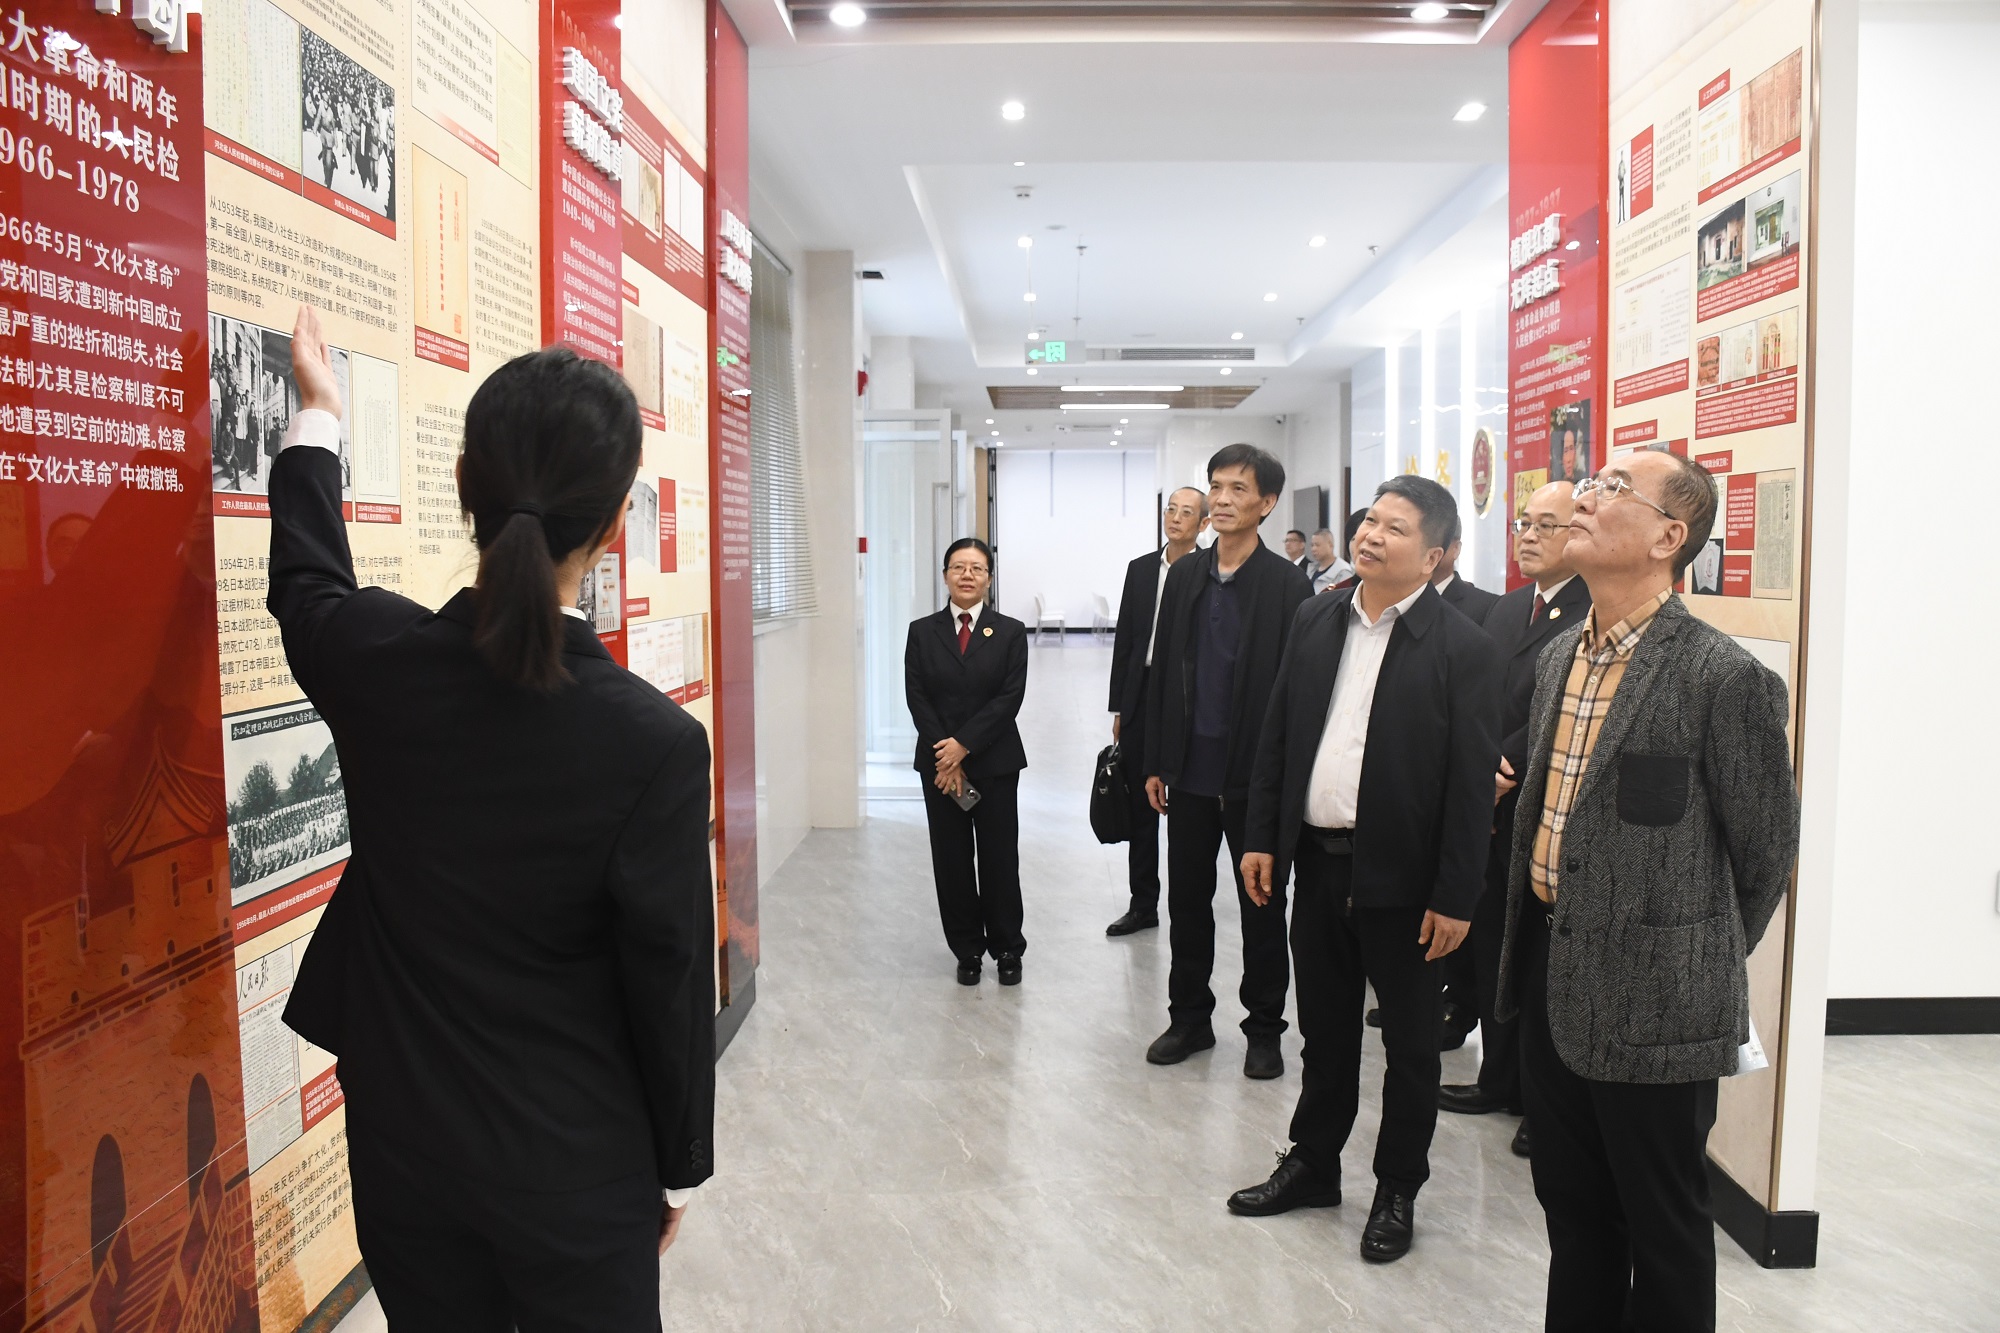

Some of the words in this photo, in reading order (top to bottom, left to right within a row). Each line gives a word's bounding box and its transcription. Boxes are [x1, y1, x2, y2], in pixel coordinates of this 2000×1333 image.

[0, 8, 179, 129] 大革命和两年
[216, 577, 270, 592] 9名日本战犯进行
[253, 1146, 350, 1231] 8年的“大跃进”运动和1959年庐山
[257, 1197, 353, 1290] 最高人民法院三机关实行合署办公,
